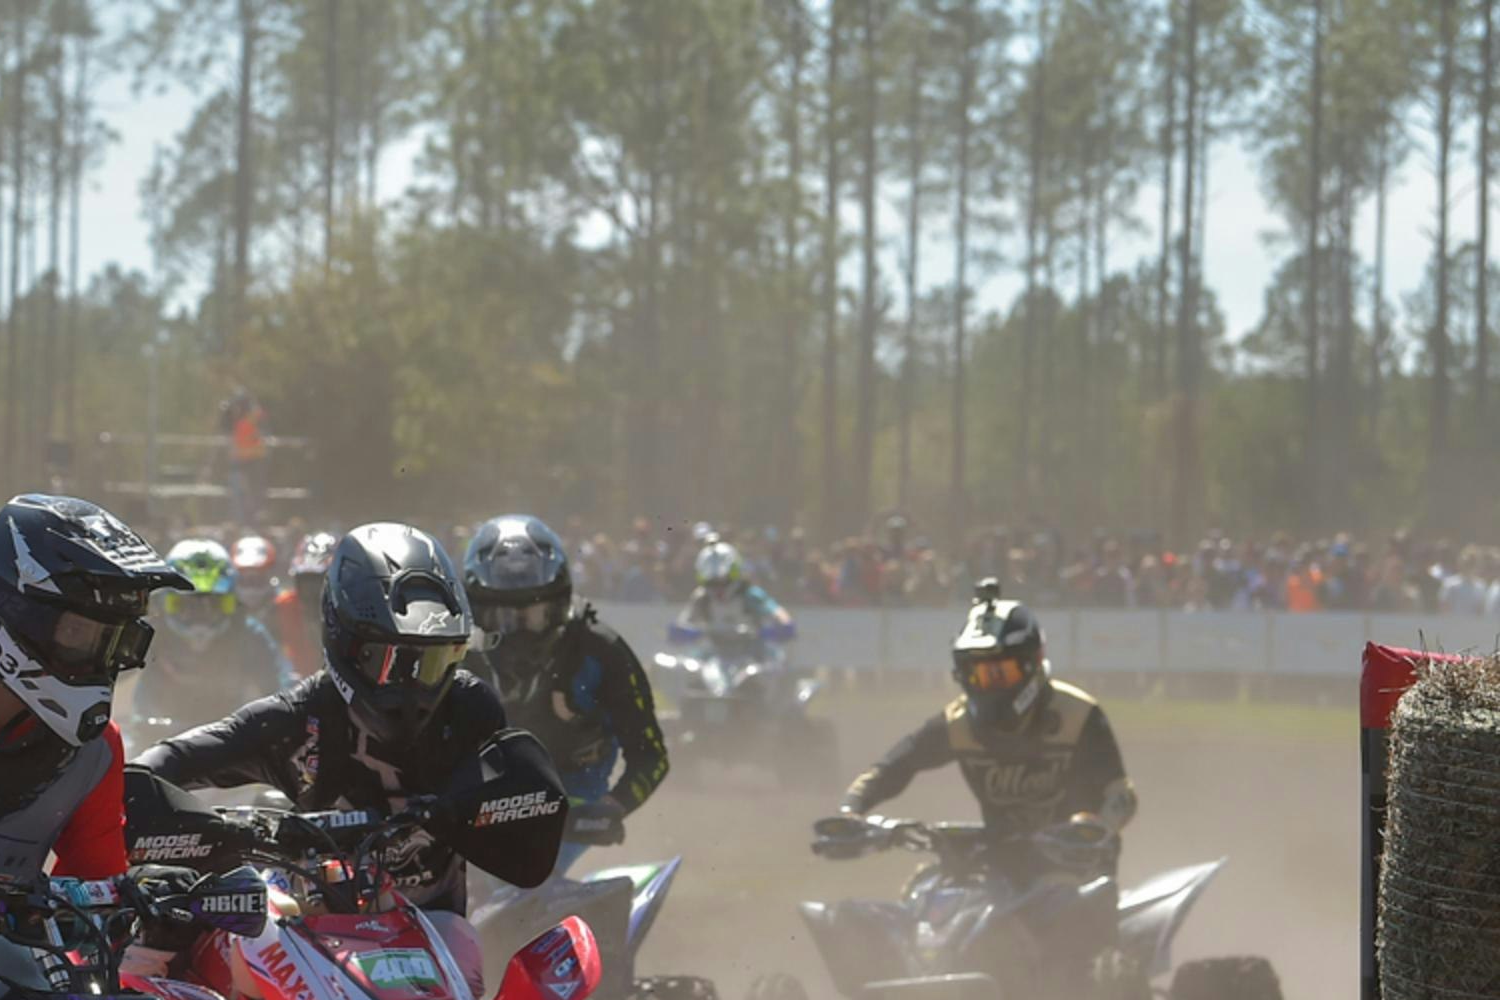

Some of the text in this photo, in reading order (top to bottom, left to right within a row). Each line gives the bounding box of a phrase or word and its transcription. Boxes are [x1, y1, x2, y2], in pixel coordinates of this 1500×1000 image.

[480, 791, 547, 813] MOOSE
[490, 801, 561, 825] RACING
[135, 833, 202, 849] MOOSE
[143, 846, 212, 861] RACING
[370, 955, 435, 983] 400
